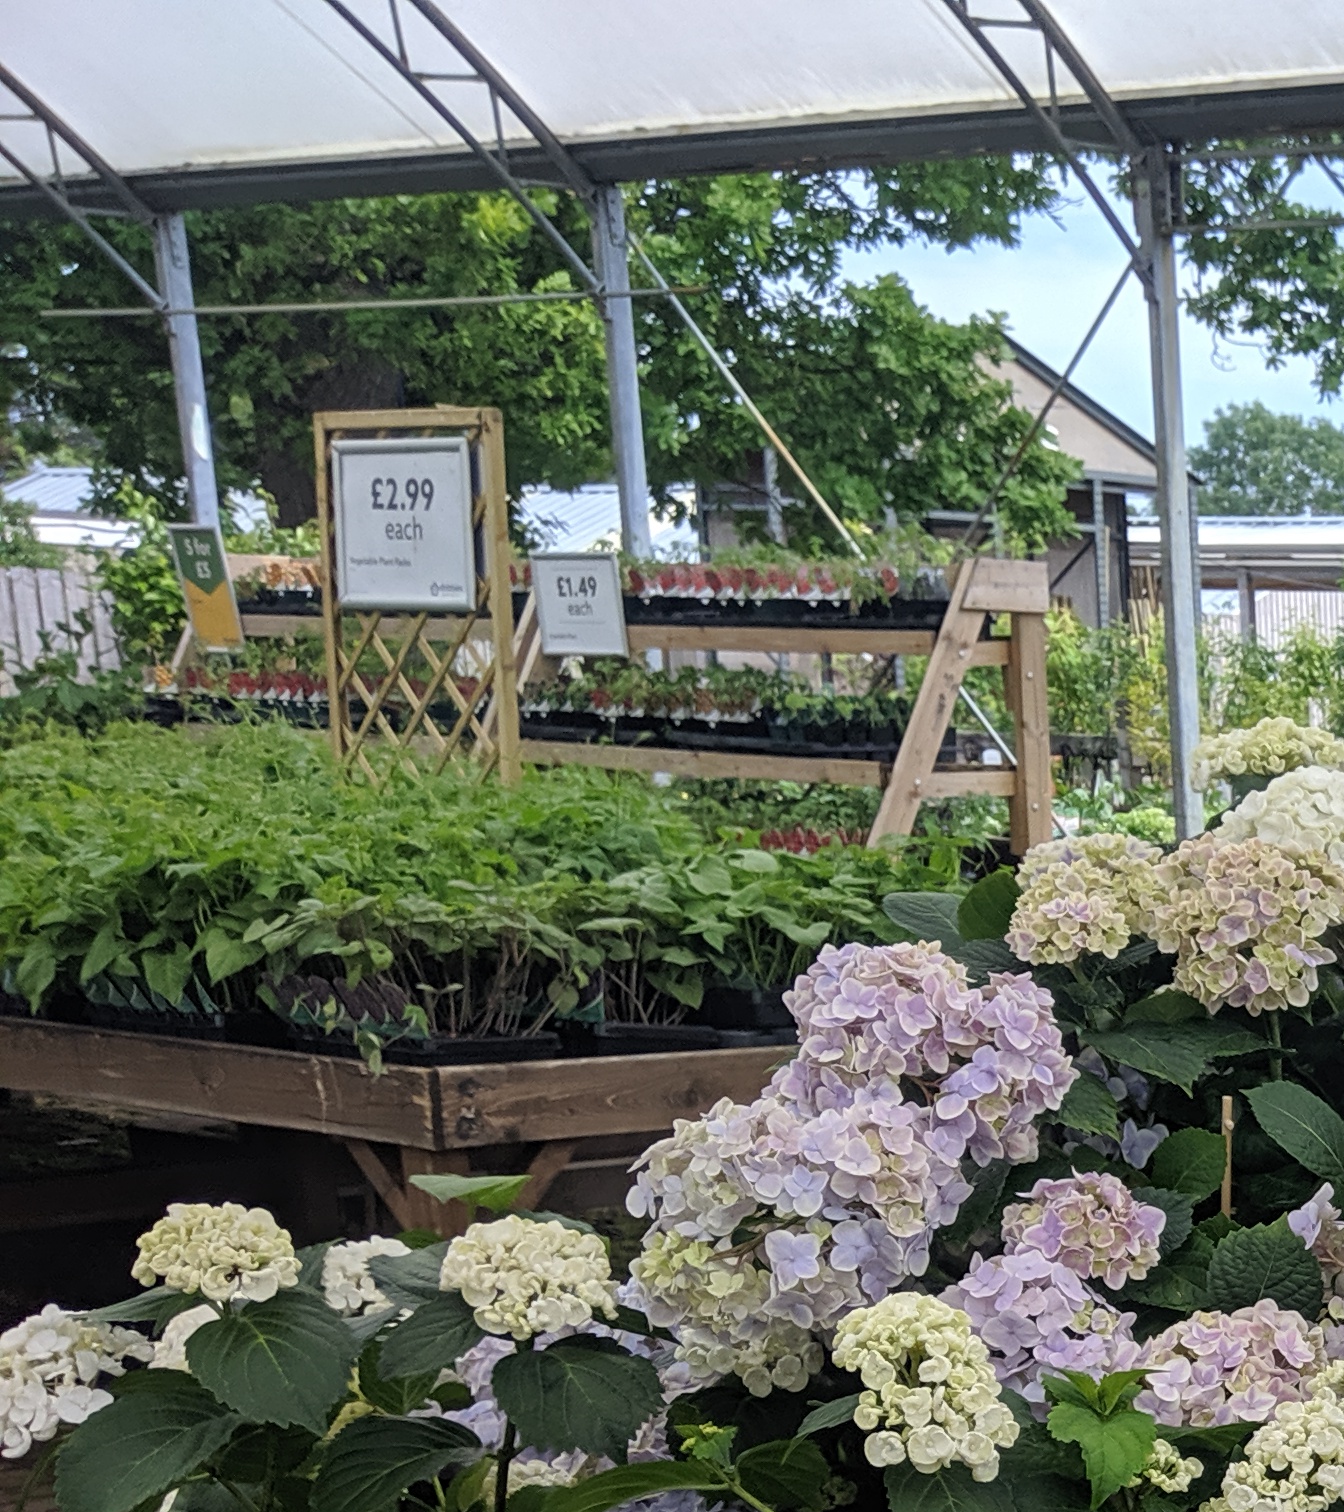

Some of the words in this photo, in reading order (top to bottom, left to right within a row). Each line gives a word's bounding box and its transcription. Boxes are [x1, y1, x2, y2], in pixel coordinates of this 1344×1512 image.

[371, 477, 435, 512] £2.99
[385, 516, 423, 541] each
[193, 536, 211, 556] for
[557, 576, 597, 598] £1.49
[568, 600, 594, 616] each
